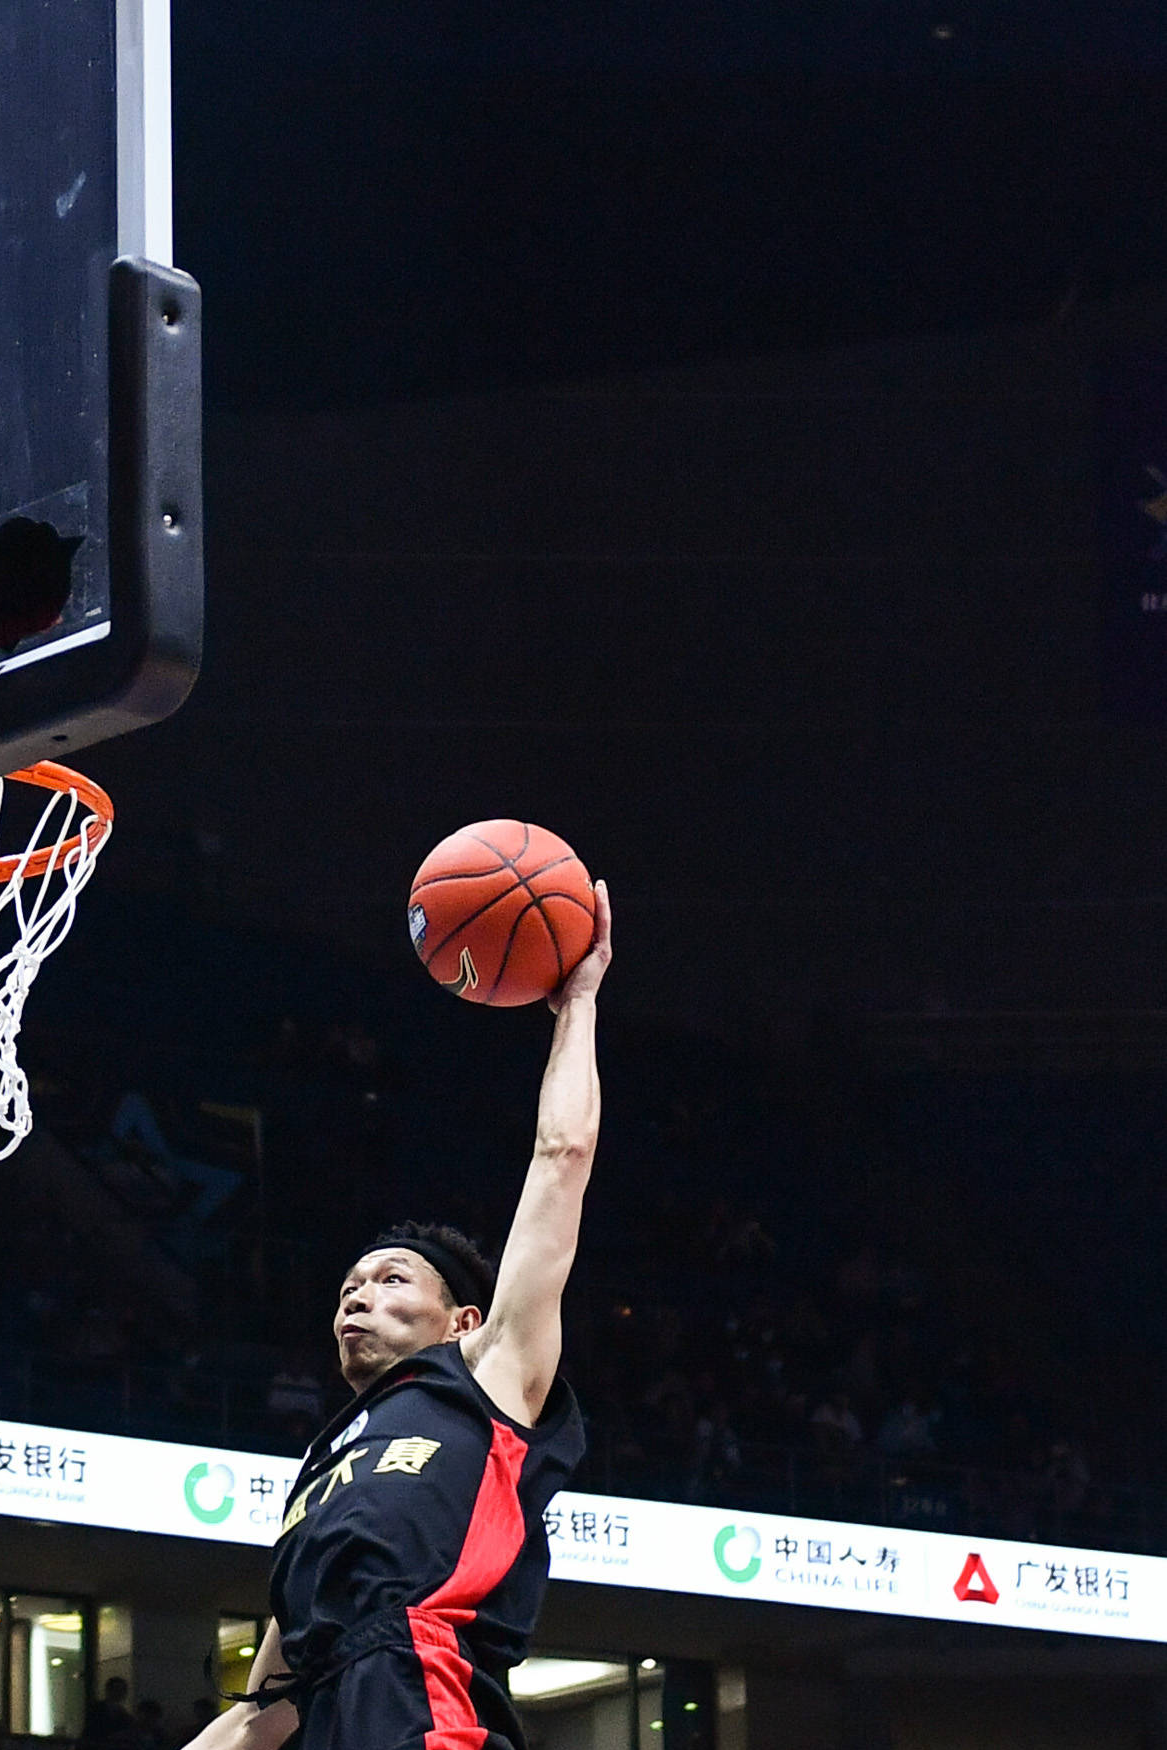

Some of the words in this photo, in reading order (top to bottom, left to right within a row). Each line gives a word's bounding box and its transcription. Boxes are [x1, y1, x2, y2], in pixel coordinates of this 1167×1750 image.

[774, 1534, 900, 1573] 中国人寿
[774, 1568, 845, 1588] CHINA
[1015, 1560, 1129, 1600] 广发银行
